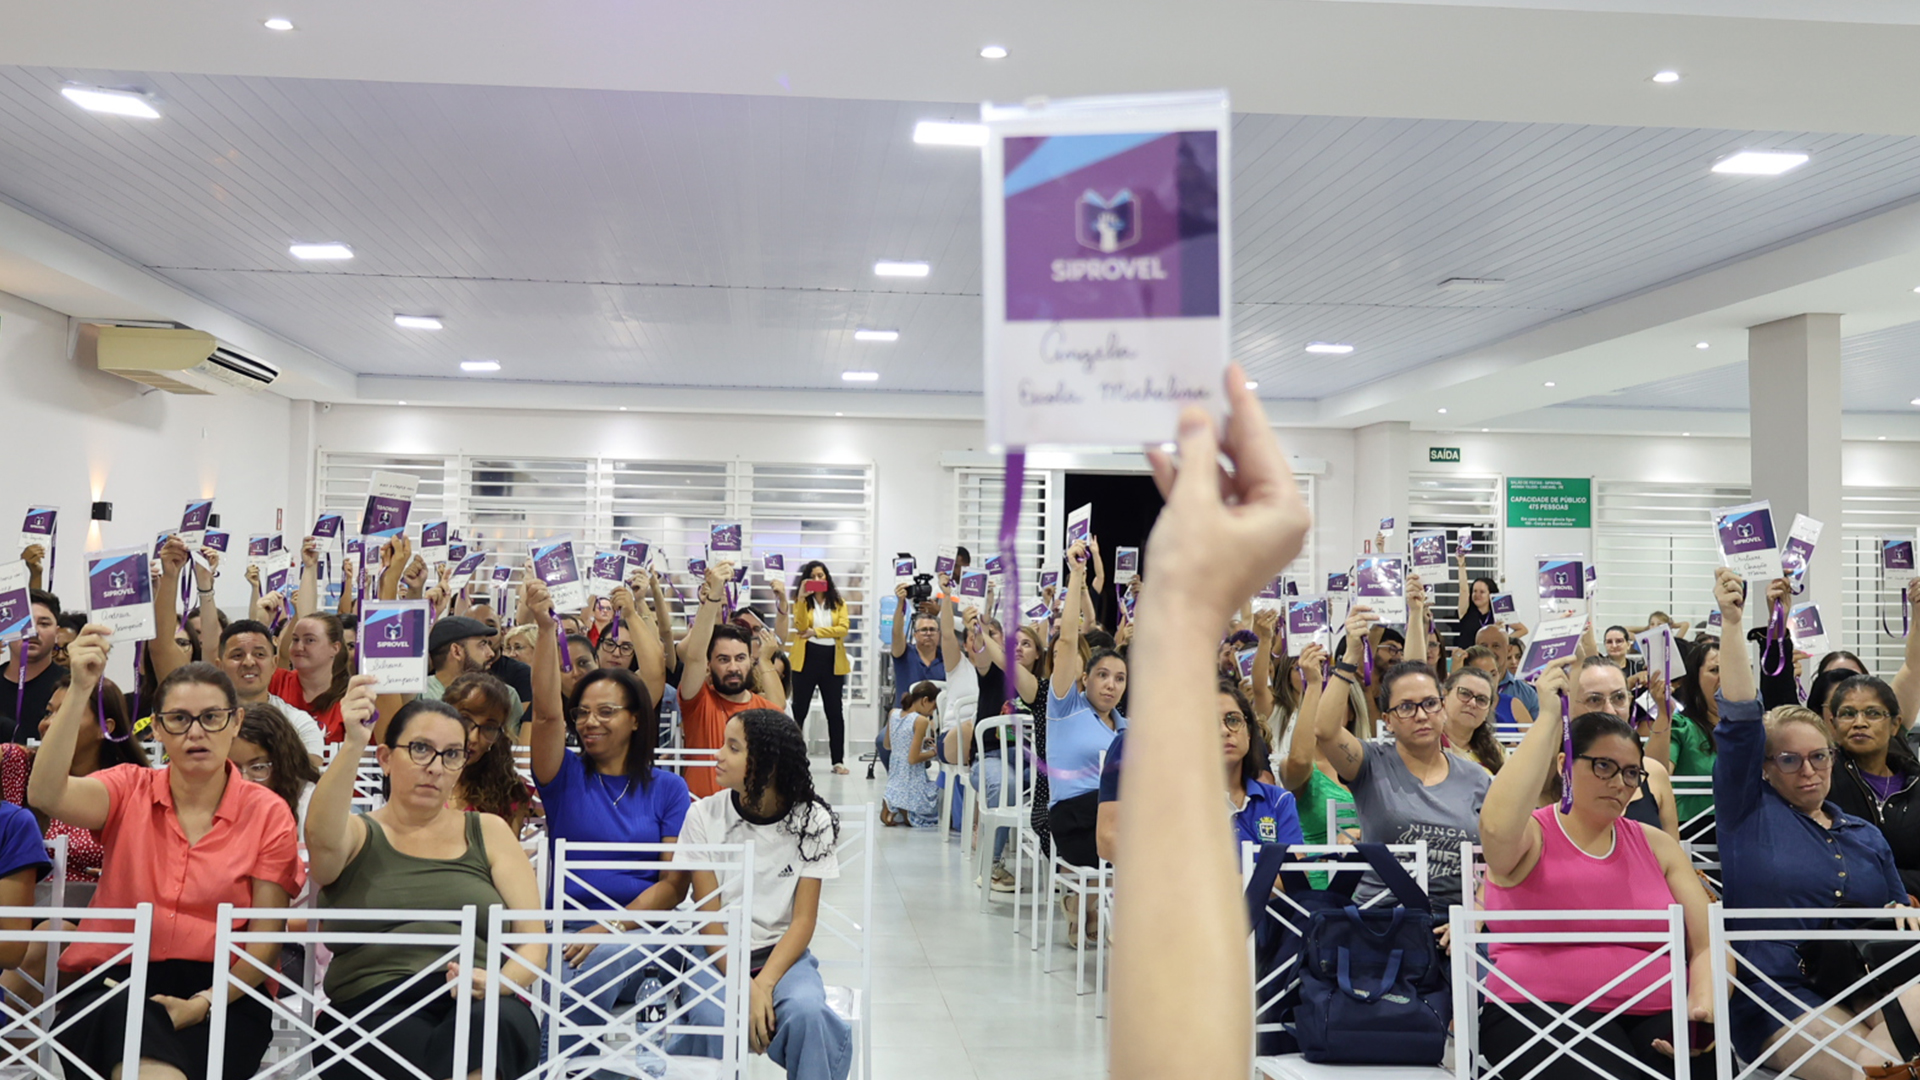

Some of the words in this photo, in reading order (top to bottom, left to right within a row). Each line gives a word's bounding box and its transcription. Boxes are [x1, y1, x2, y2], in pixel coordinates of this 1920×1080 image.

[1051, 257, 1168, 282] SIPROVEL
[1430, 448, 1459, 460] SAÍDA
[1560, 495, 1587, 504] PÚBLICO
[1732, 536, 1762, 546] SIPROVEL
[103, 587, 136, 599] SIPROVEL
[1410, 824, 1468, 839] NUNCA
